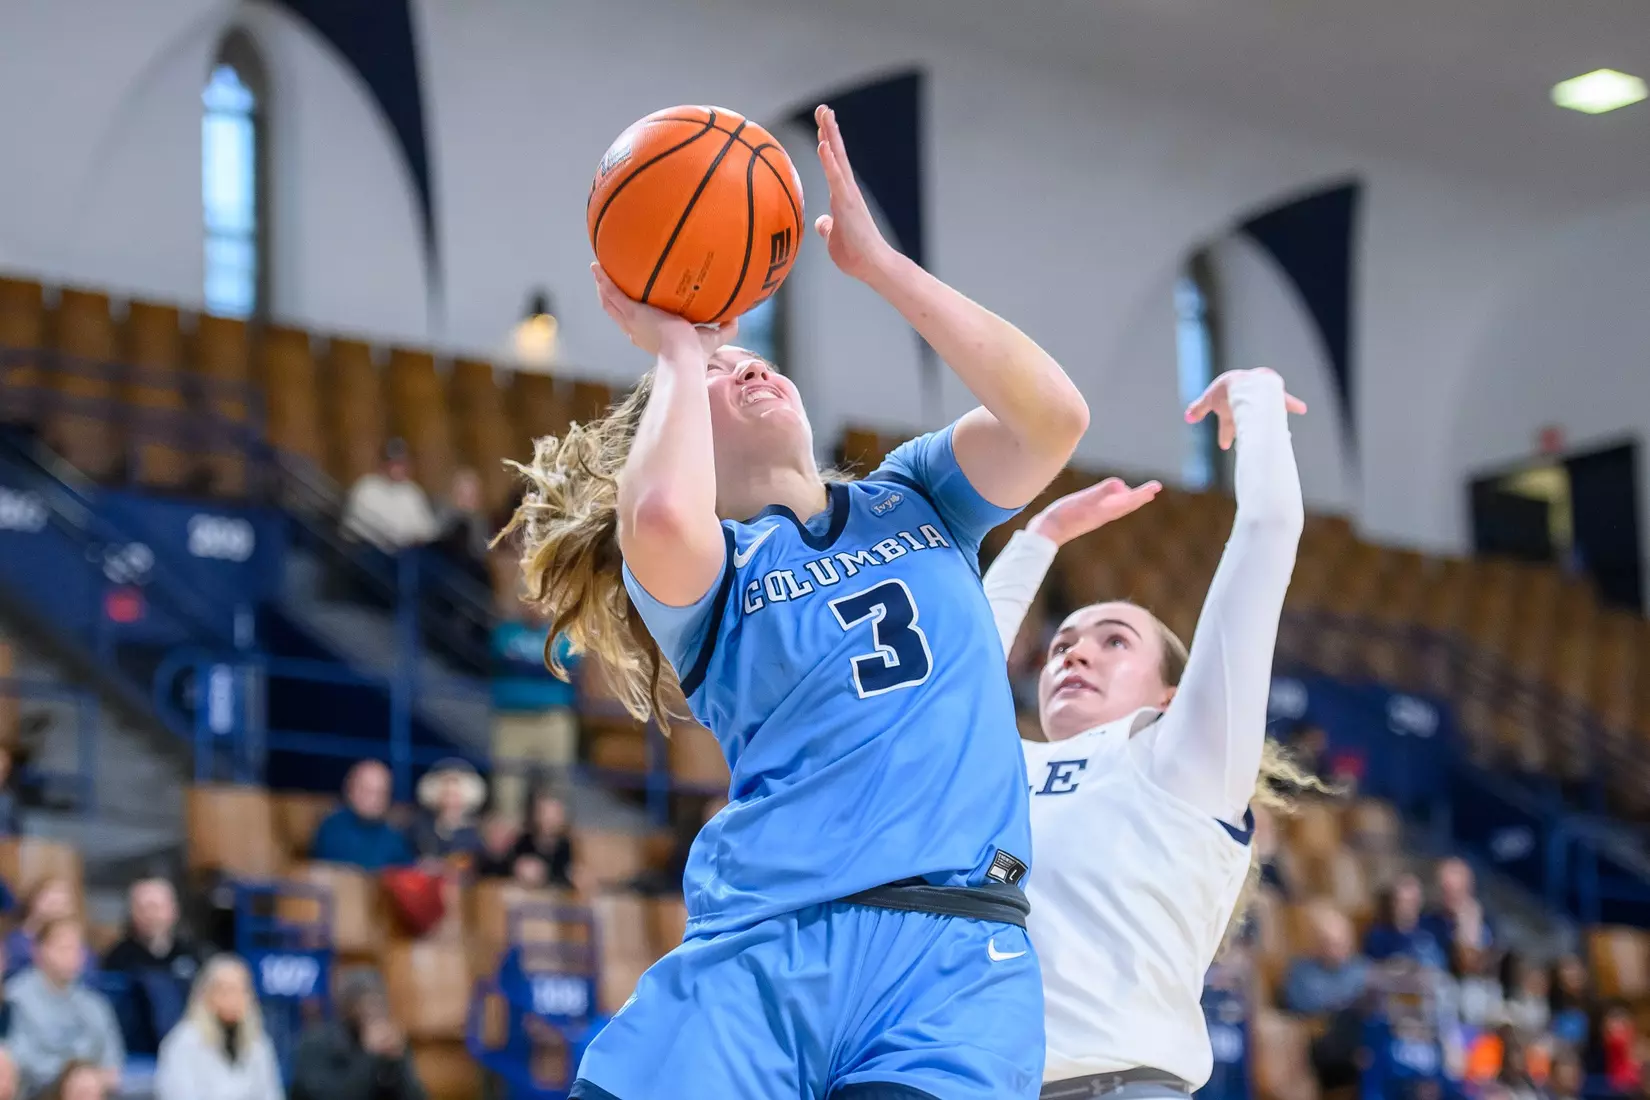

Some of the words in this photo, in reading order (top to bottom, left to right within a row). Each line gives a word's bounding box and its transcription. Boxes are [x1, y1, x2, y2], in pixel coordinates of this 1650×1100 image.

[873, 499, 893, 514] Ivy
[744, 523, 950, 615] COLUMBIA
[827, 578, 934, 700] 3
